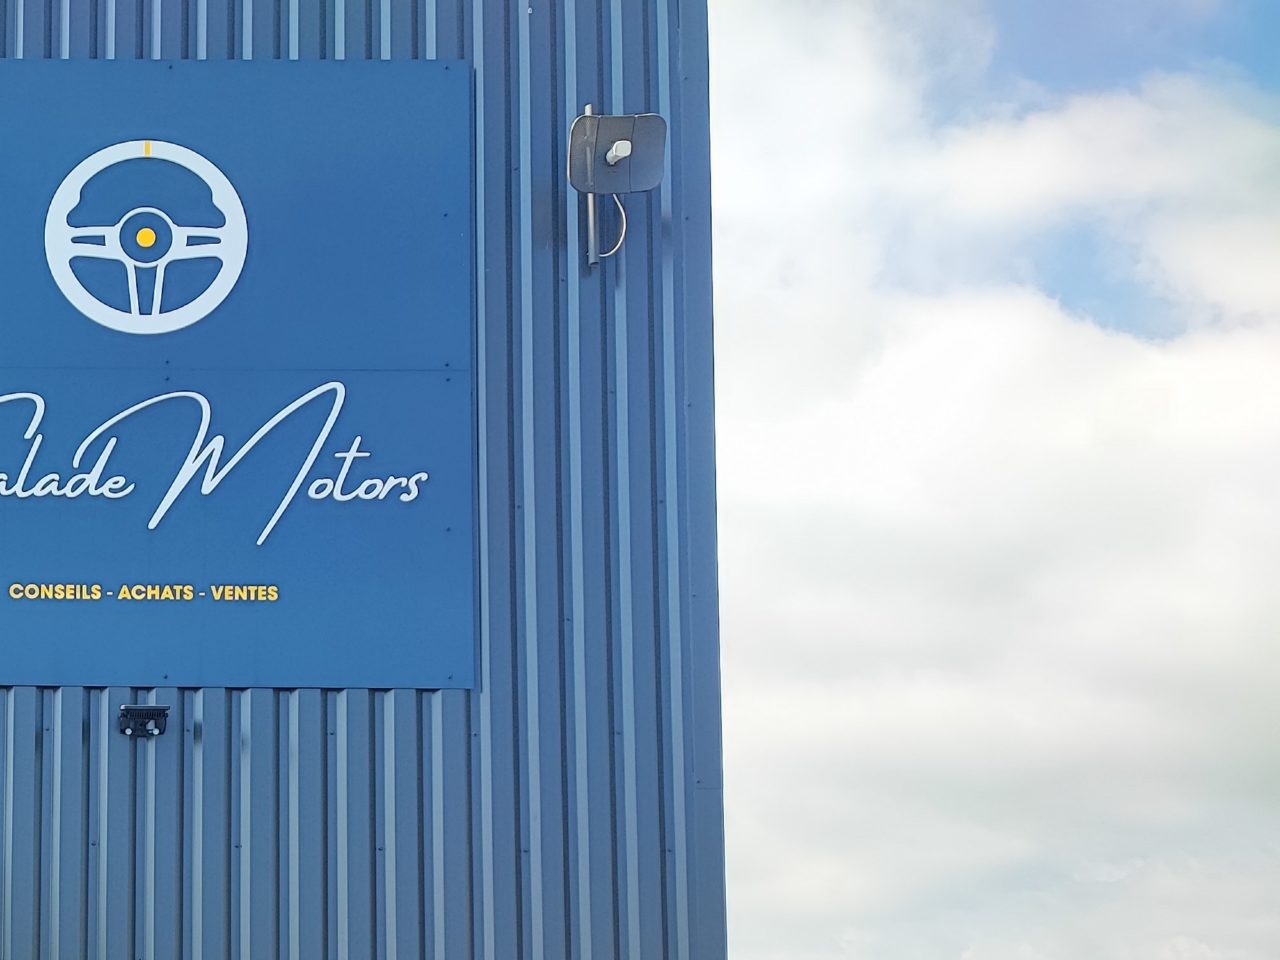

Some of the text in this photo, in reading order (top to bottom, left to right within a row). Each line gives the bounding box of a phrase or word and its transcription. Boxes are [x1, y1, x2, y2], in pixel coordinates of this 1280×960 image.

[72, 381, 429, 546] Motors
[9, 583, 102, 600] CONSEILS
[118, 584, 194, 601] ACHATS
[210, 585, 279, 601] VENTES
